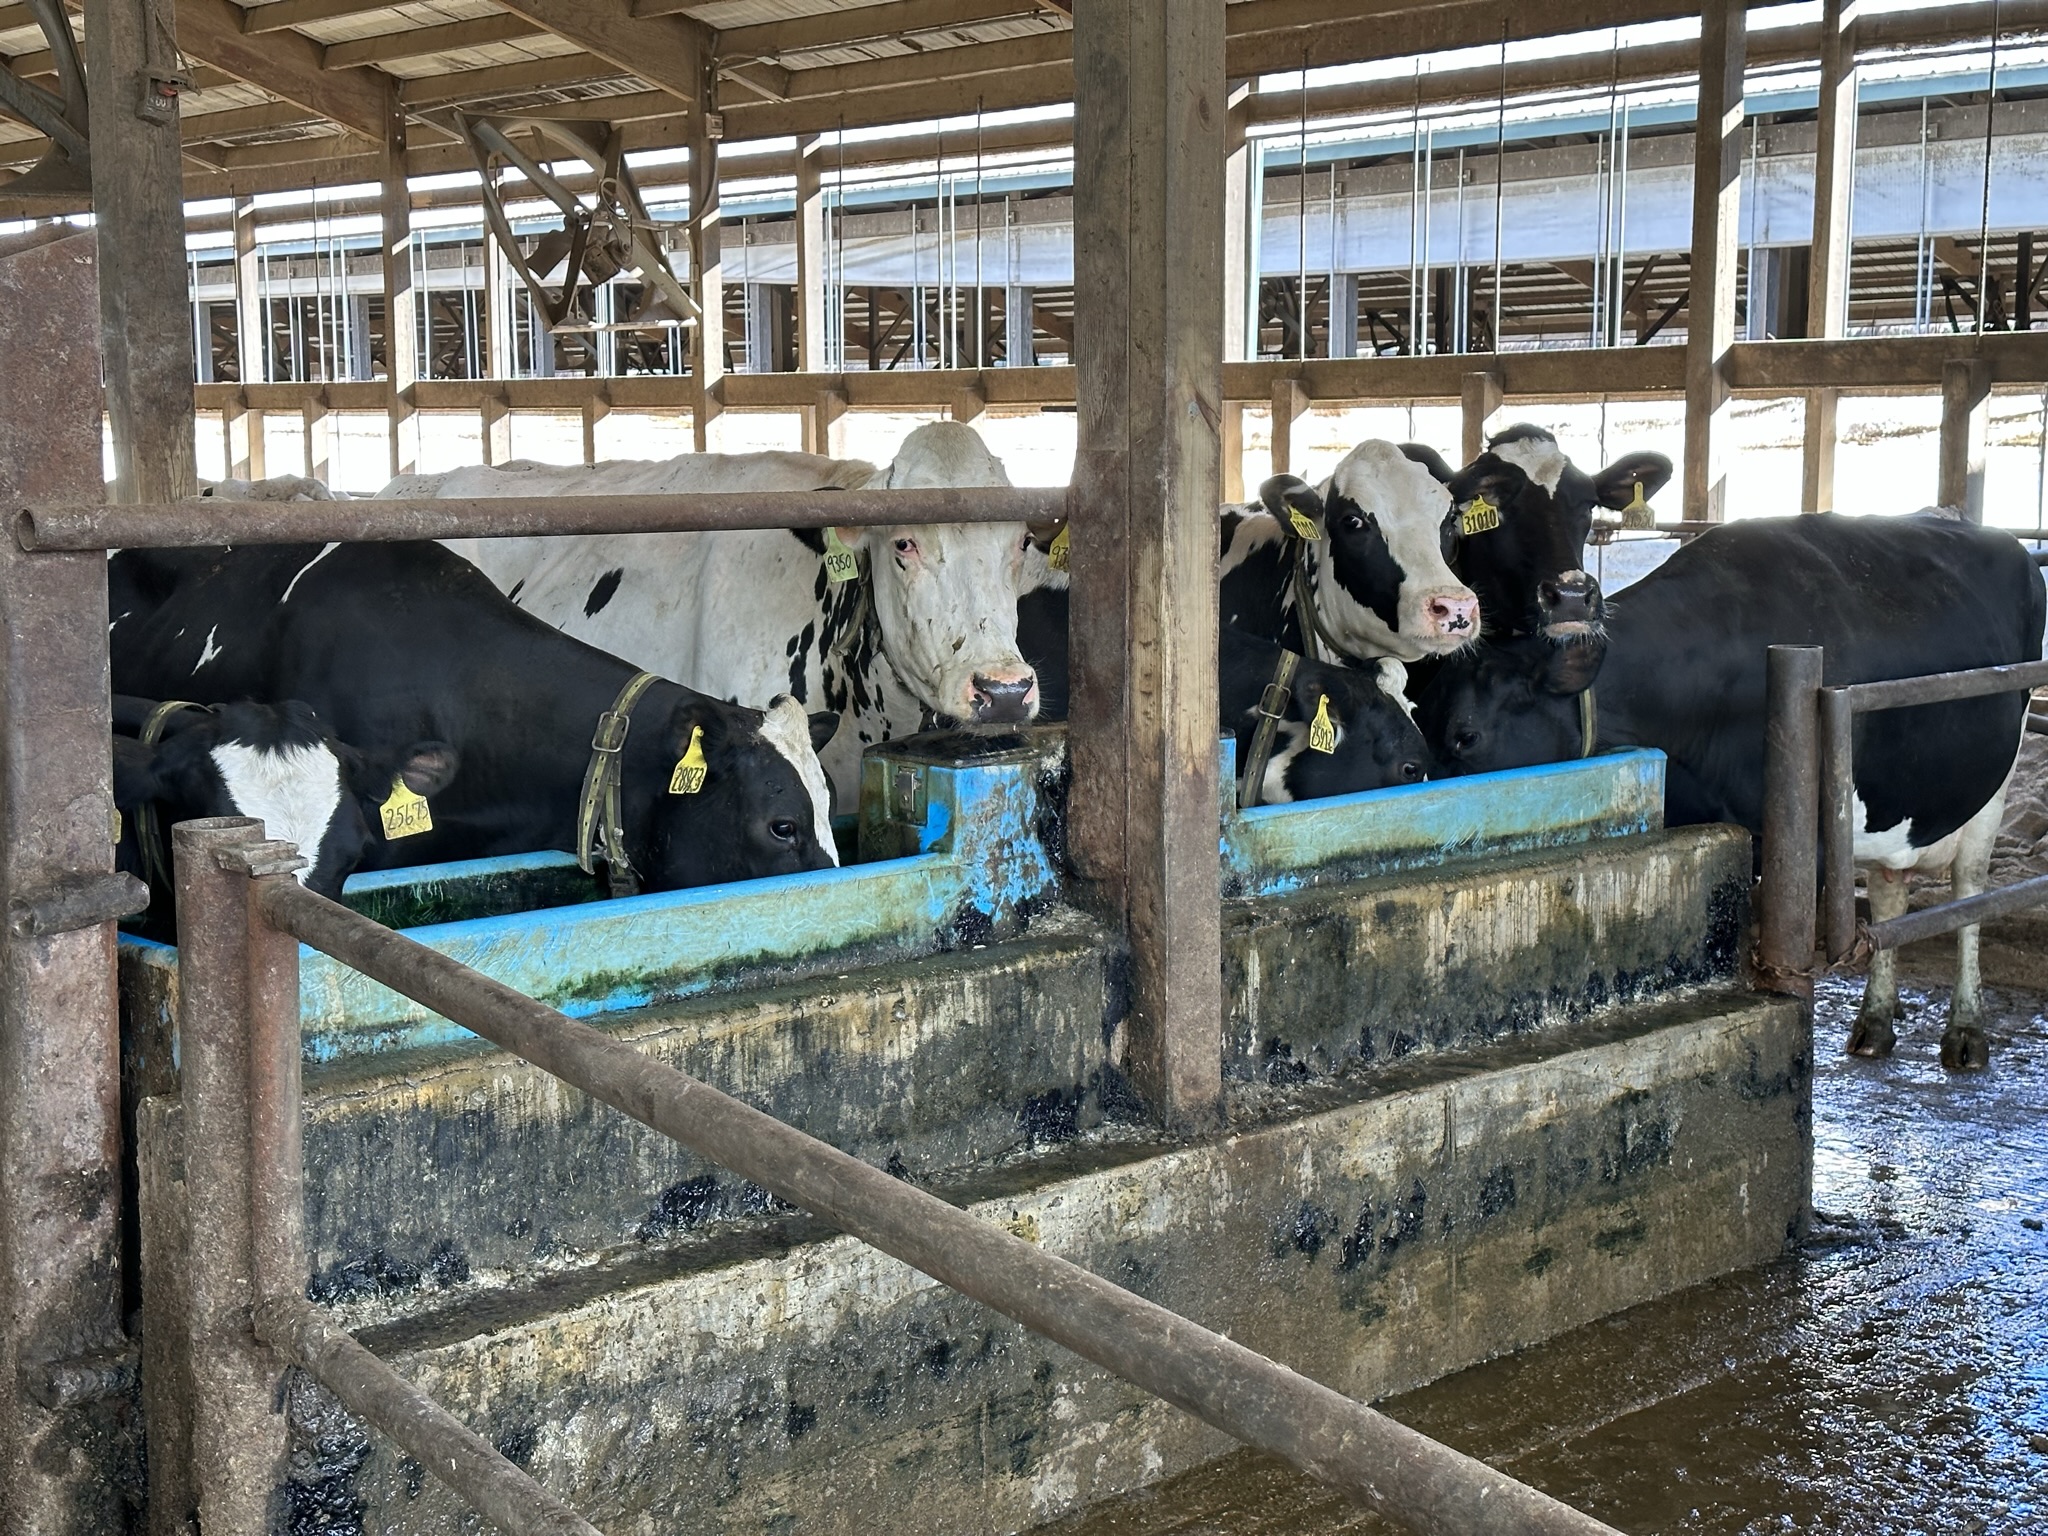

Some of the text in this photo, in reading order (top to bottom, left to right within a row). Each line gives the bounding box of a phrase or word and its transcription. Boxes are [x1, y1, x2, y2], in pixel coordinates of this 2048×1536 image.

[1464, 509, 1497, 533] 31010
[827, 552, 852, 574] 9350
[385, 799, 429, 831] 25675
